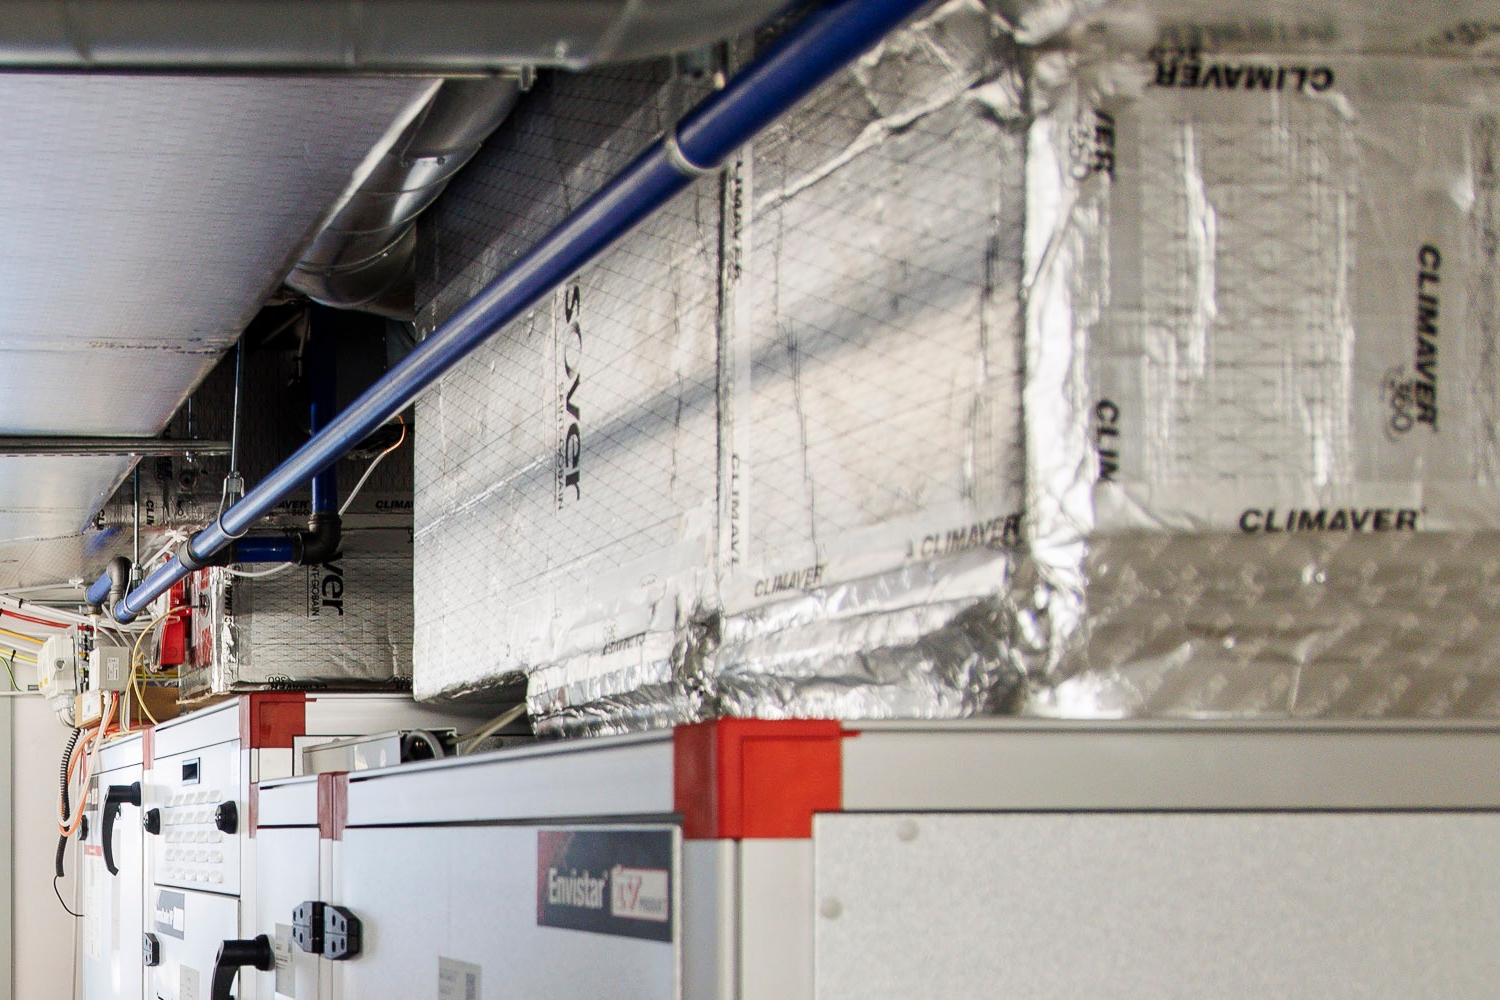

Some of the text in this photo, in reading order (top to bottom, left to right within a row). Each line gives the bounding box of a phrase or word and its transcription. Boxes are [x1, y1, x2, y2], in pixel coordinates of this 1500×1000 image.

[1153, 62, 1337, 92] CLIMAVER
[1415, 243, 1442, 428] CLIMAVER
[1238, 508, 1421, 533] CLIMAVER
[754, 564, 825, 599] CLIMAVER
[548, 866, 604, 910] Envistar
